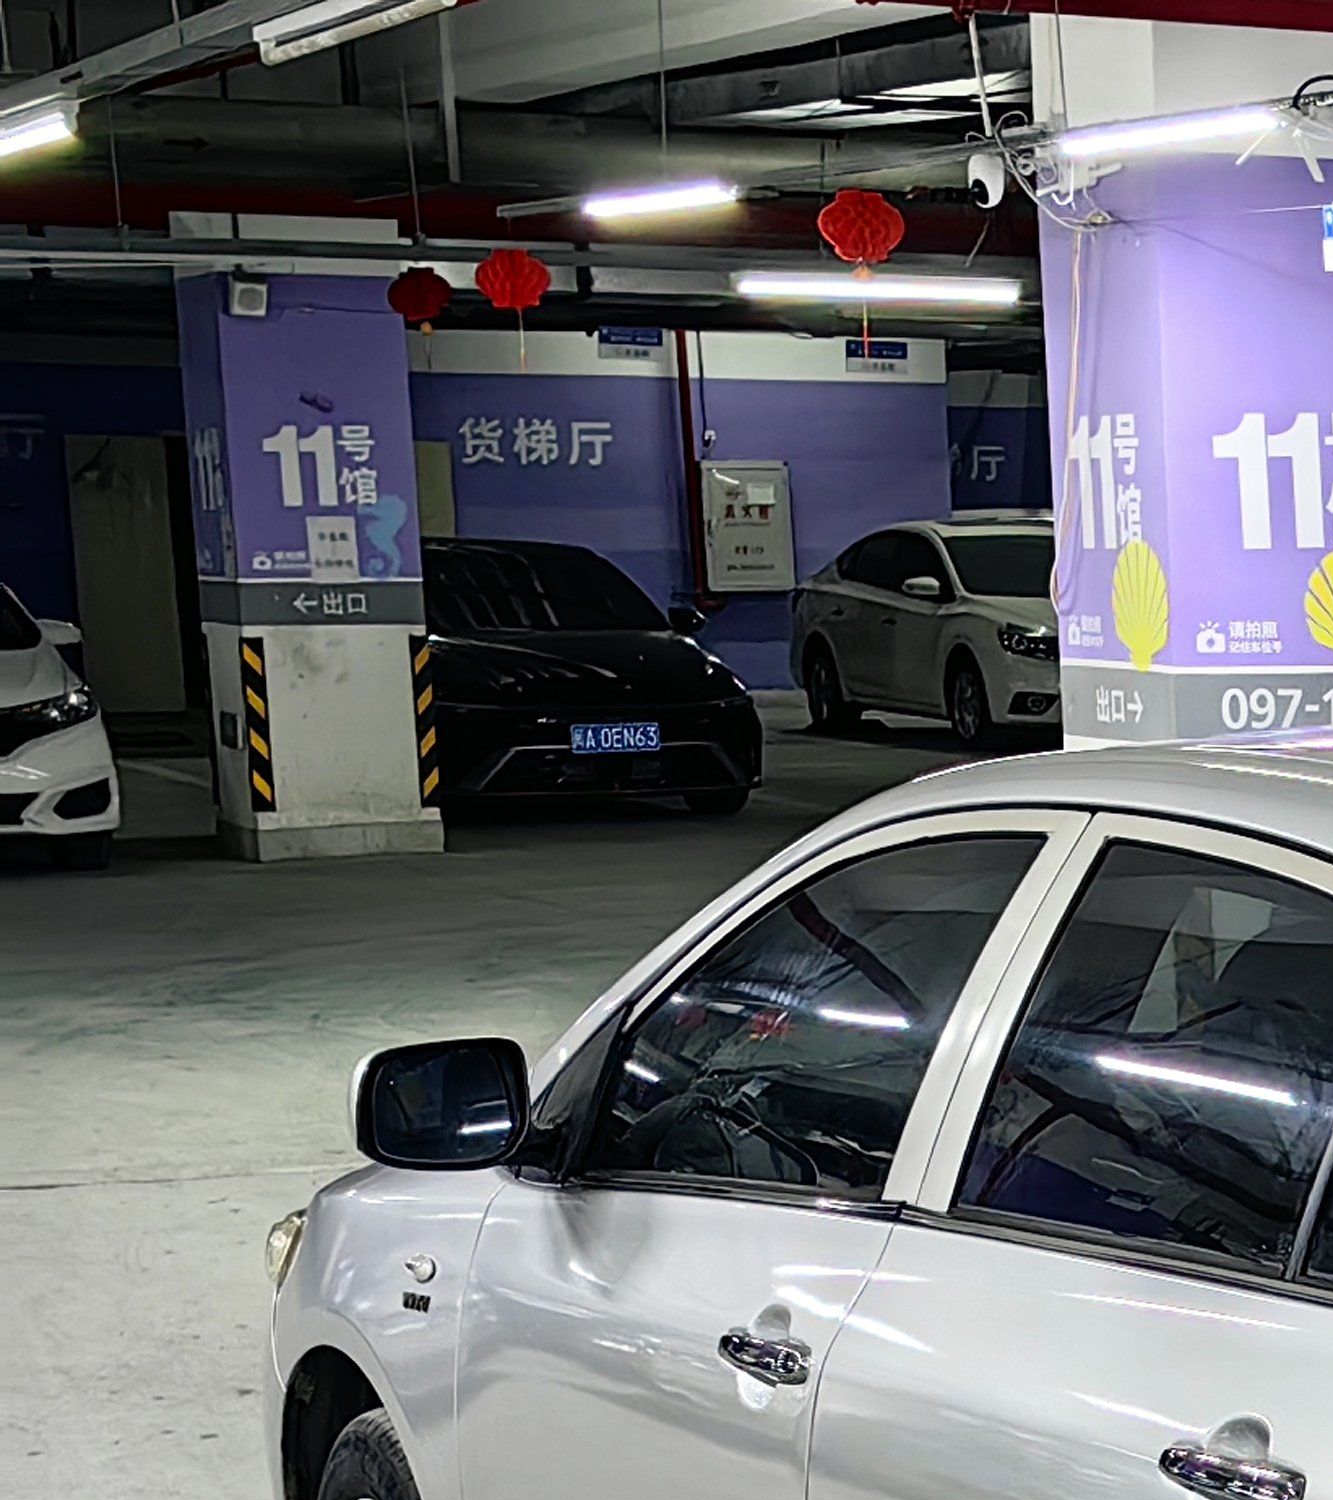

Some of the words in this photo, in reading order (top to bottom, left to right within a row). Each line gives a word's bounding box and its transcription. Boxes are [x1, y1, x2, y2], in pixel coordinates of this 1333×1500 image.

[458, 417, 613, 466] 货梯厅
[322, 592, 368, 615] 出口
[1228, 620, 1278, 639] 请拍照
[1228, 641, 1283, 654] 记住车位号
[1096, 686, 1126, 723] 出口
